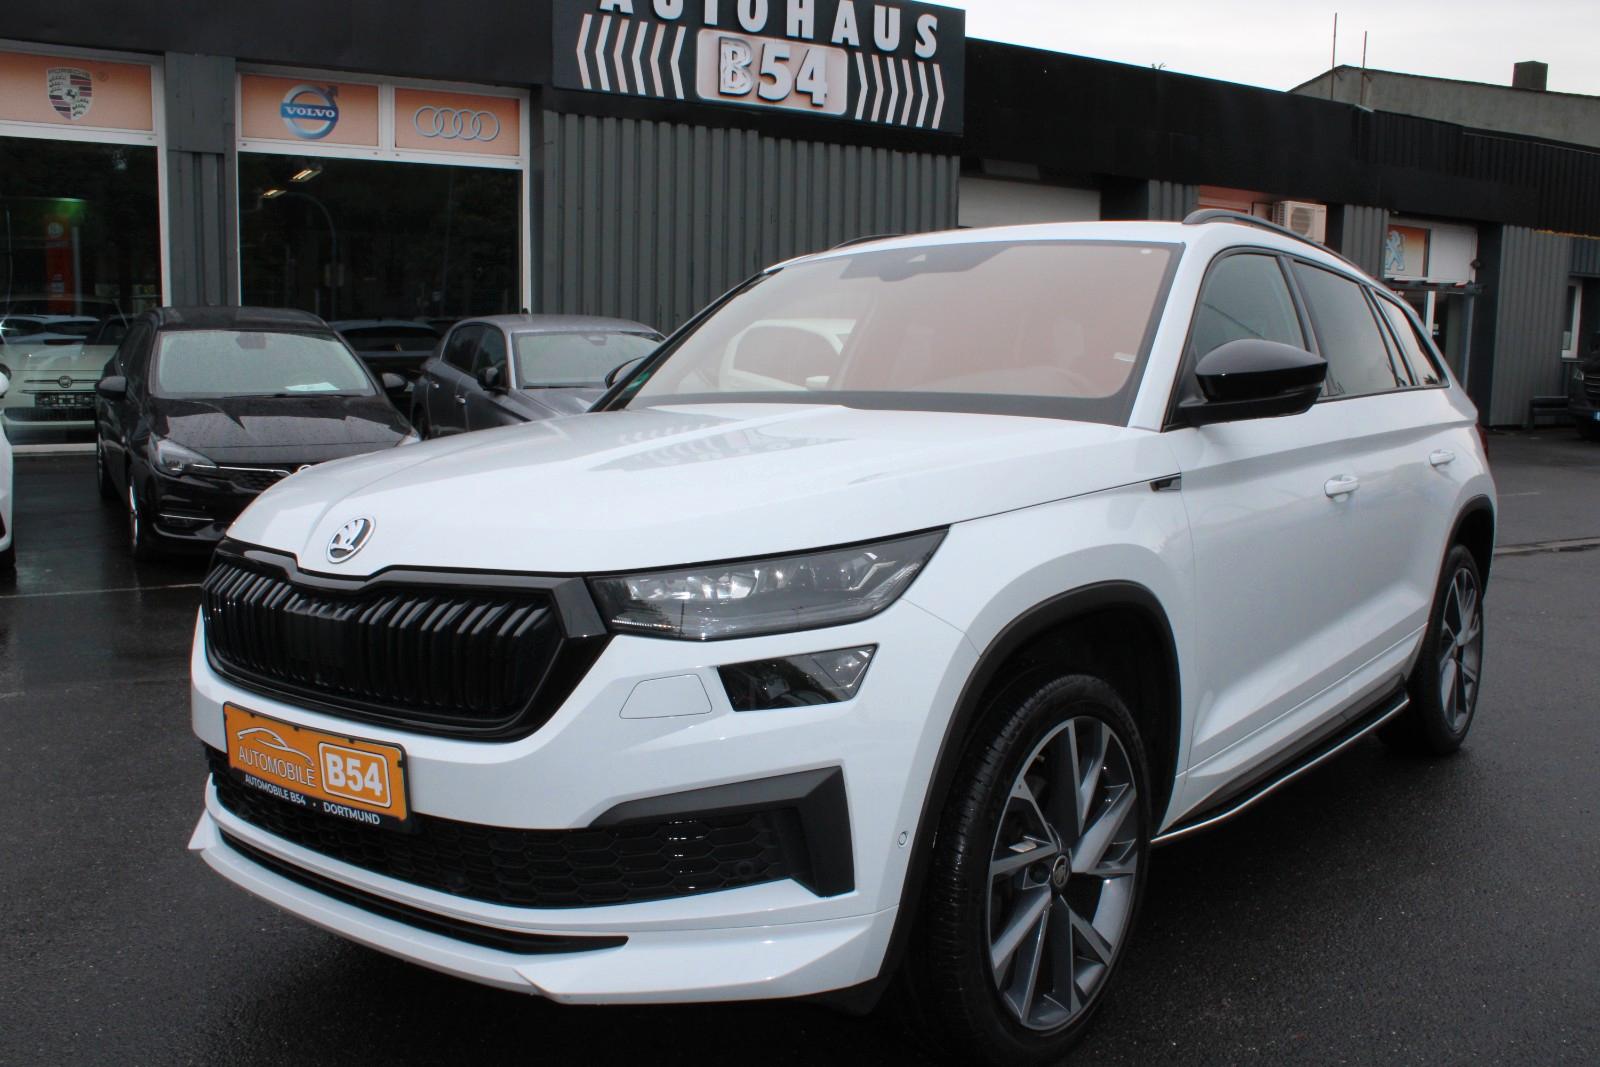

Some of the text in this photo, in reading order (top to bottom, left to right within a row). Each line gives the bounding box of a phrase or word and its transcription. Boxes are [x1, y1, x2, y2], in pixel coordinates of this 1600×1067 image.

[598, 0, 938, 58] OHAUS
[718, 37, 828, 107] B54
[285, 106, 336, 118] VOLVO
[238, 746, 382, 796] AUTOMOBILE B54
[245, 775, 380, 825] AUTOMOBILE B54 DORTMUND
